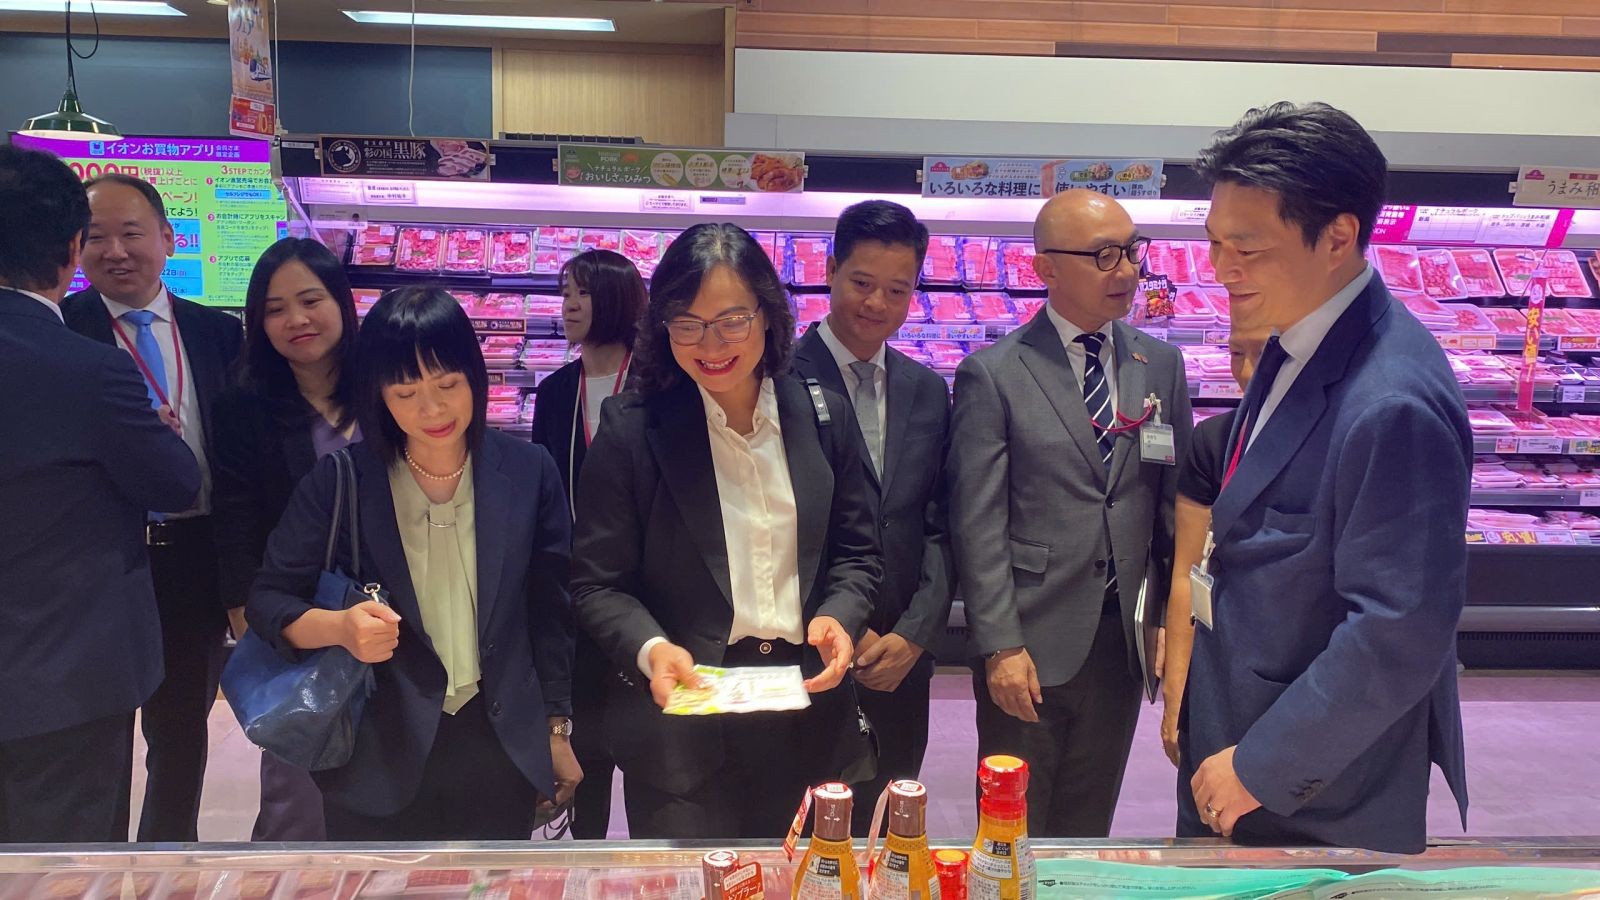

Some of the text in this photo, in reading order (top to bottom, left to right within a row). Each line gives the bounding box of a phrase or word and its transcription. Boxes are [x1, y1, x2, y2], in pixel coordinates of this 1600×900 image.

[107, 143, 214, 157] イオンお買物アプリ
[393, 141, 427, 160] 黒豚
[585, 172, 651, 184] おいしさのひみつ
[930, 181, 1041, 197] いろいろな料理に
